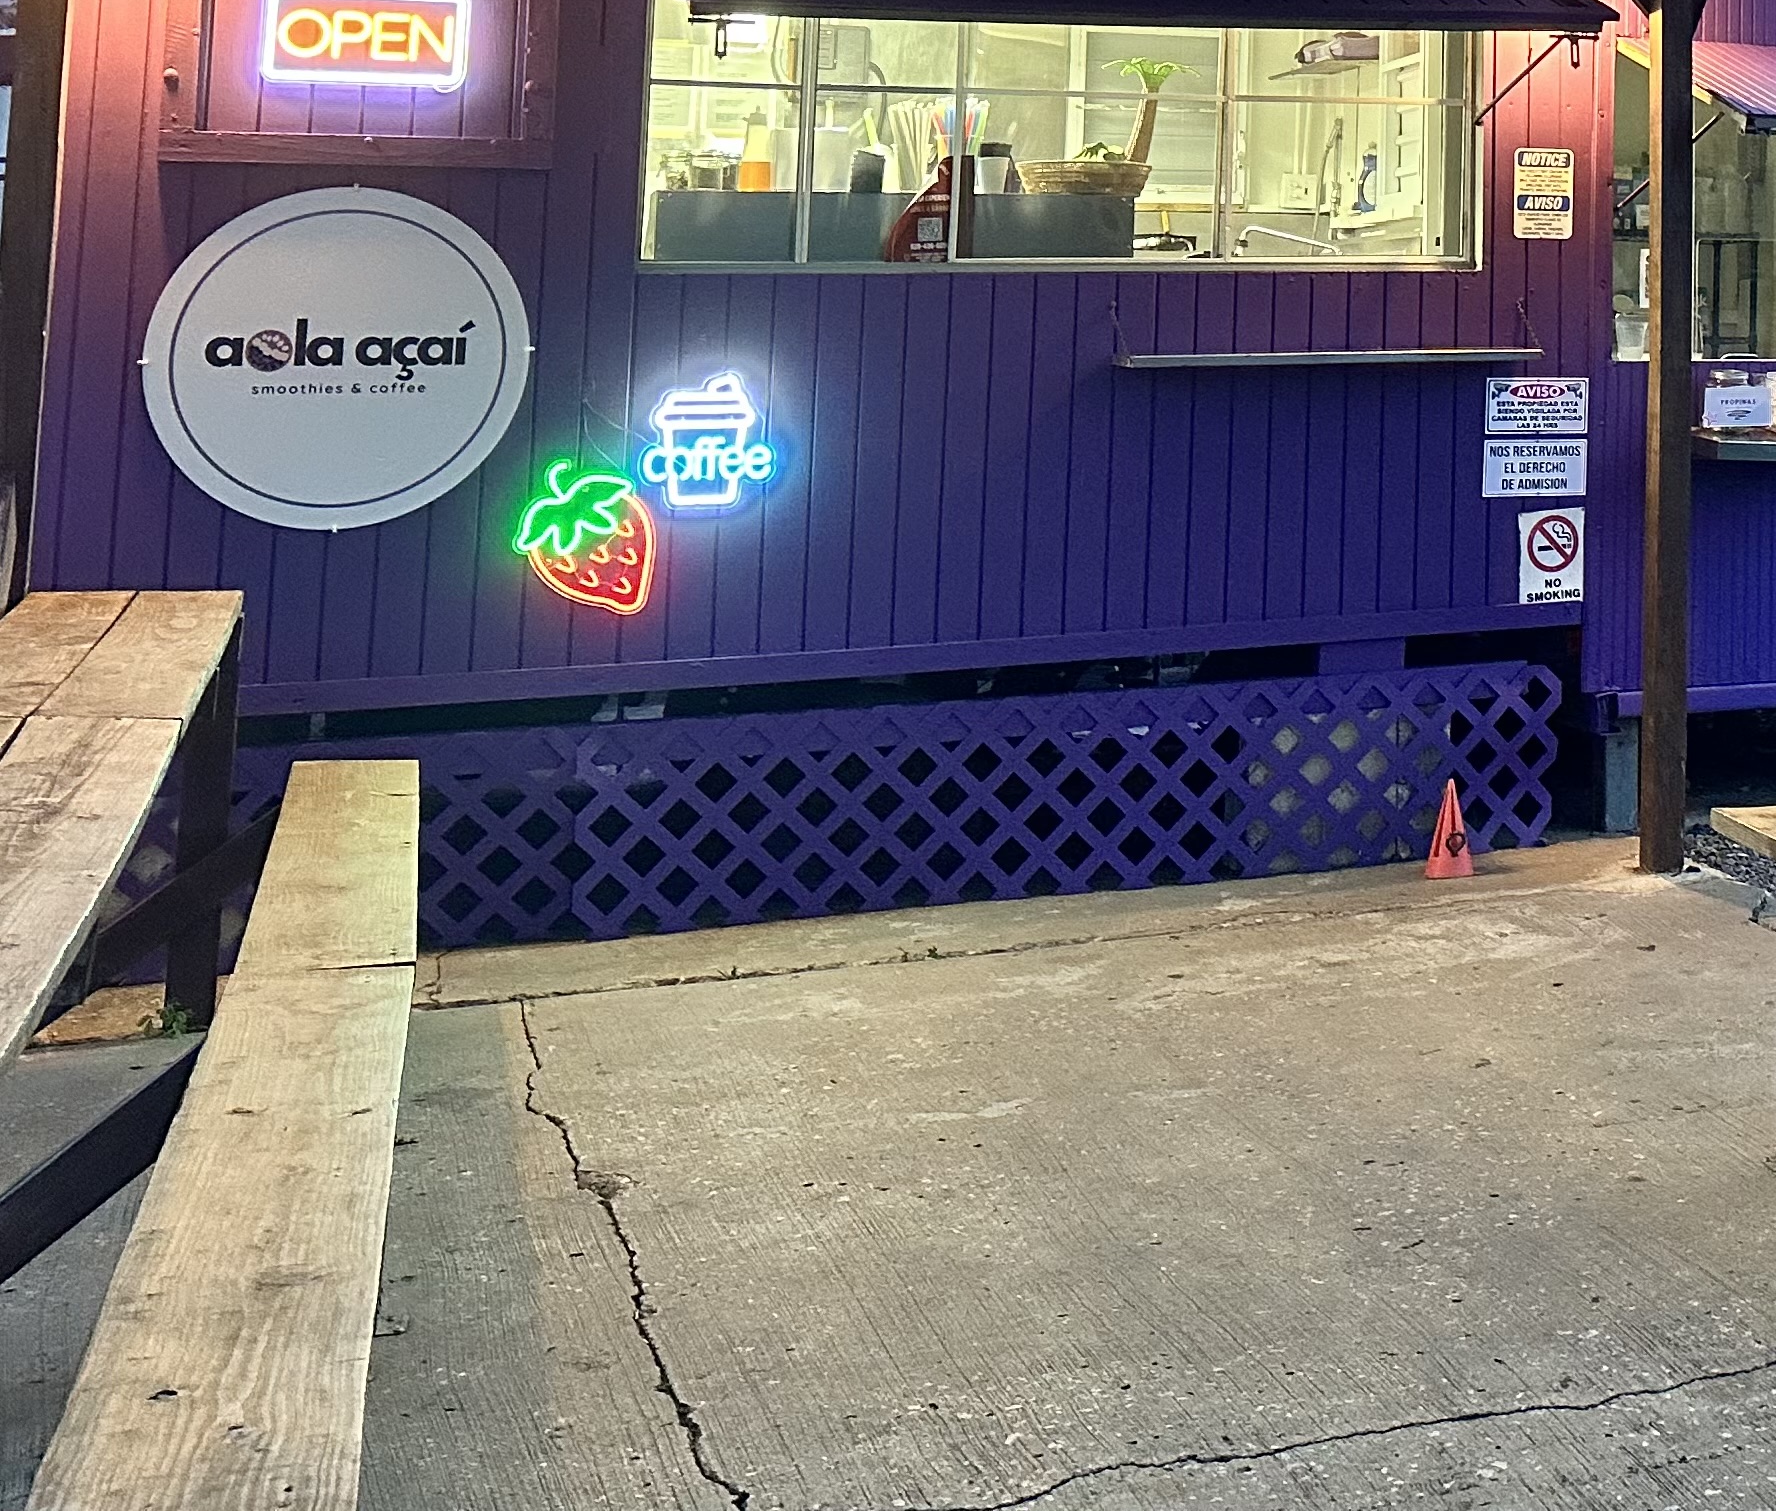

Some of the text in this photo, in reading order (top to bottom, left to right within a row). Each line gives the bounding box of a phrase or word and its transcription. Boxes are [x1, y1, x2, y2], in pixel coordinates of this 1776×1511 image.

[277, 8, 455, 63] OPEN
[1521, 152, 1567, 167] NOTICE
[1524, 196, 1563, 210] AVISO
[355, 320, 476, 381] açaí
[251, 382, 427, 395] smoothies & coffee
[1517, 386, 1560, 398] AVISO
[1720, 398, 1757, 406] PROPINAS
[1489, 445, 1581, 458] NOS RESERVAMOS
[642, 436, 773, 483] coffee
[1504, 461, 1566, 474] EL DERECHO
[1501, 477, 1568, 491] DE ADMISION
[1544, 578, 1562, 589] NO
[1526, 588, 1581, 603] SMOKING
